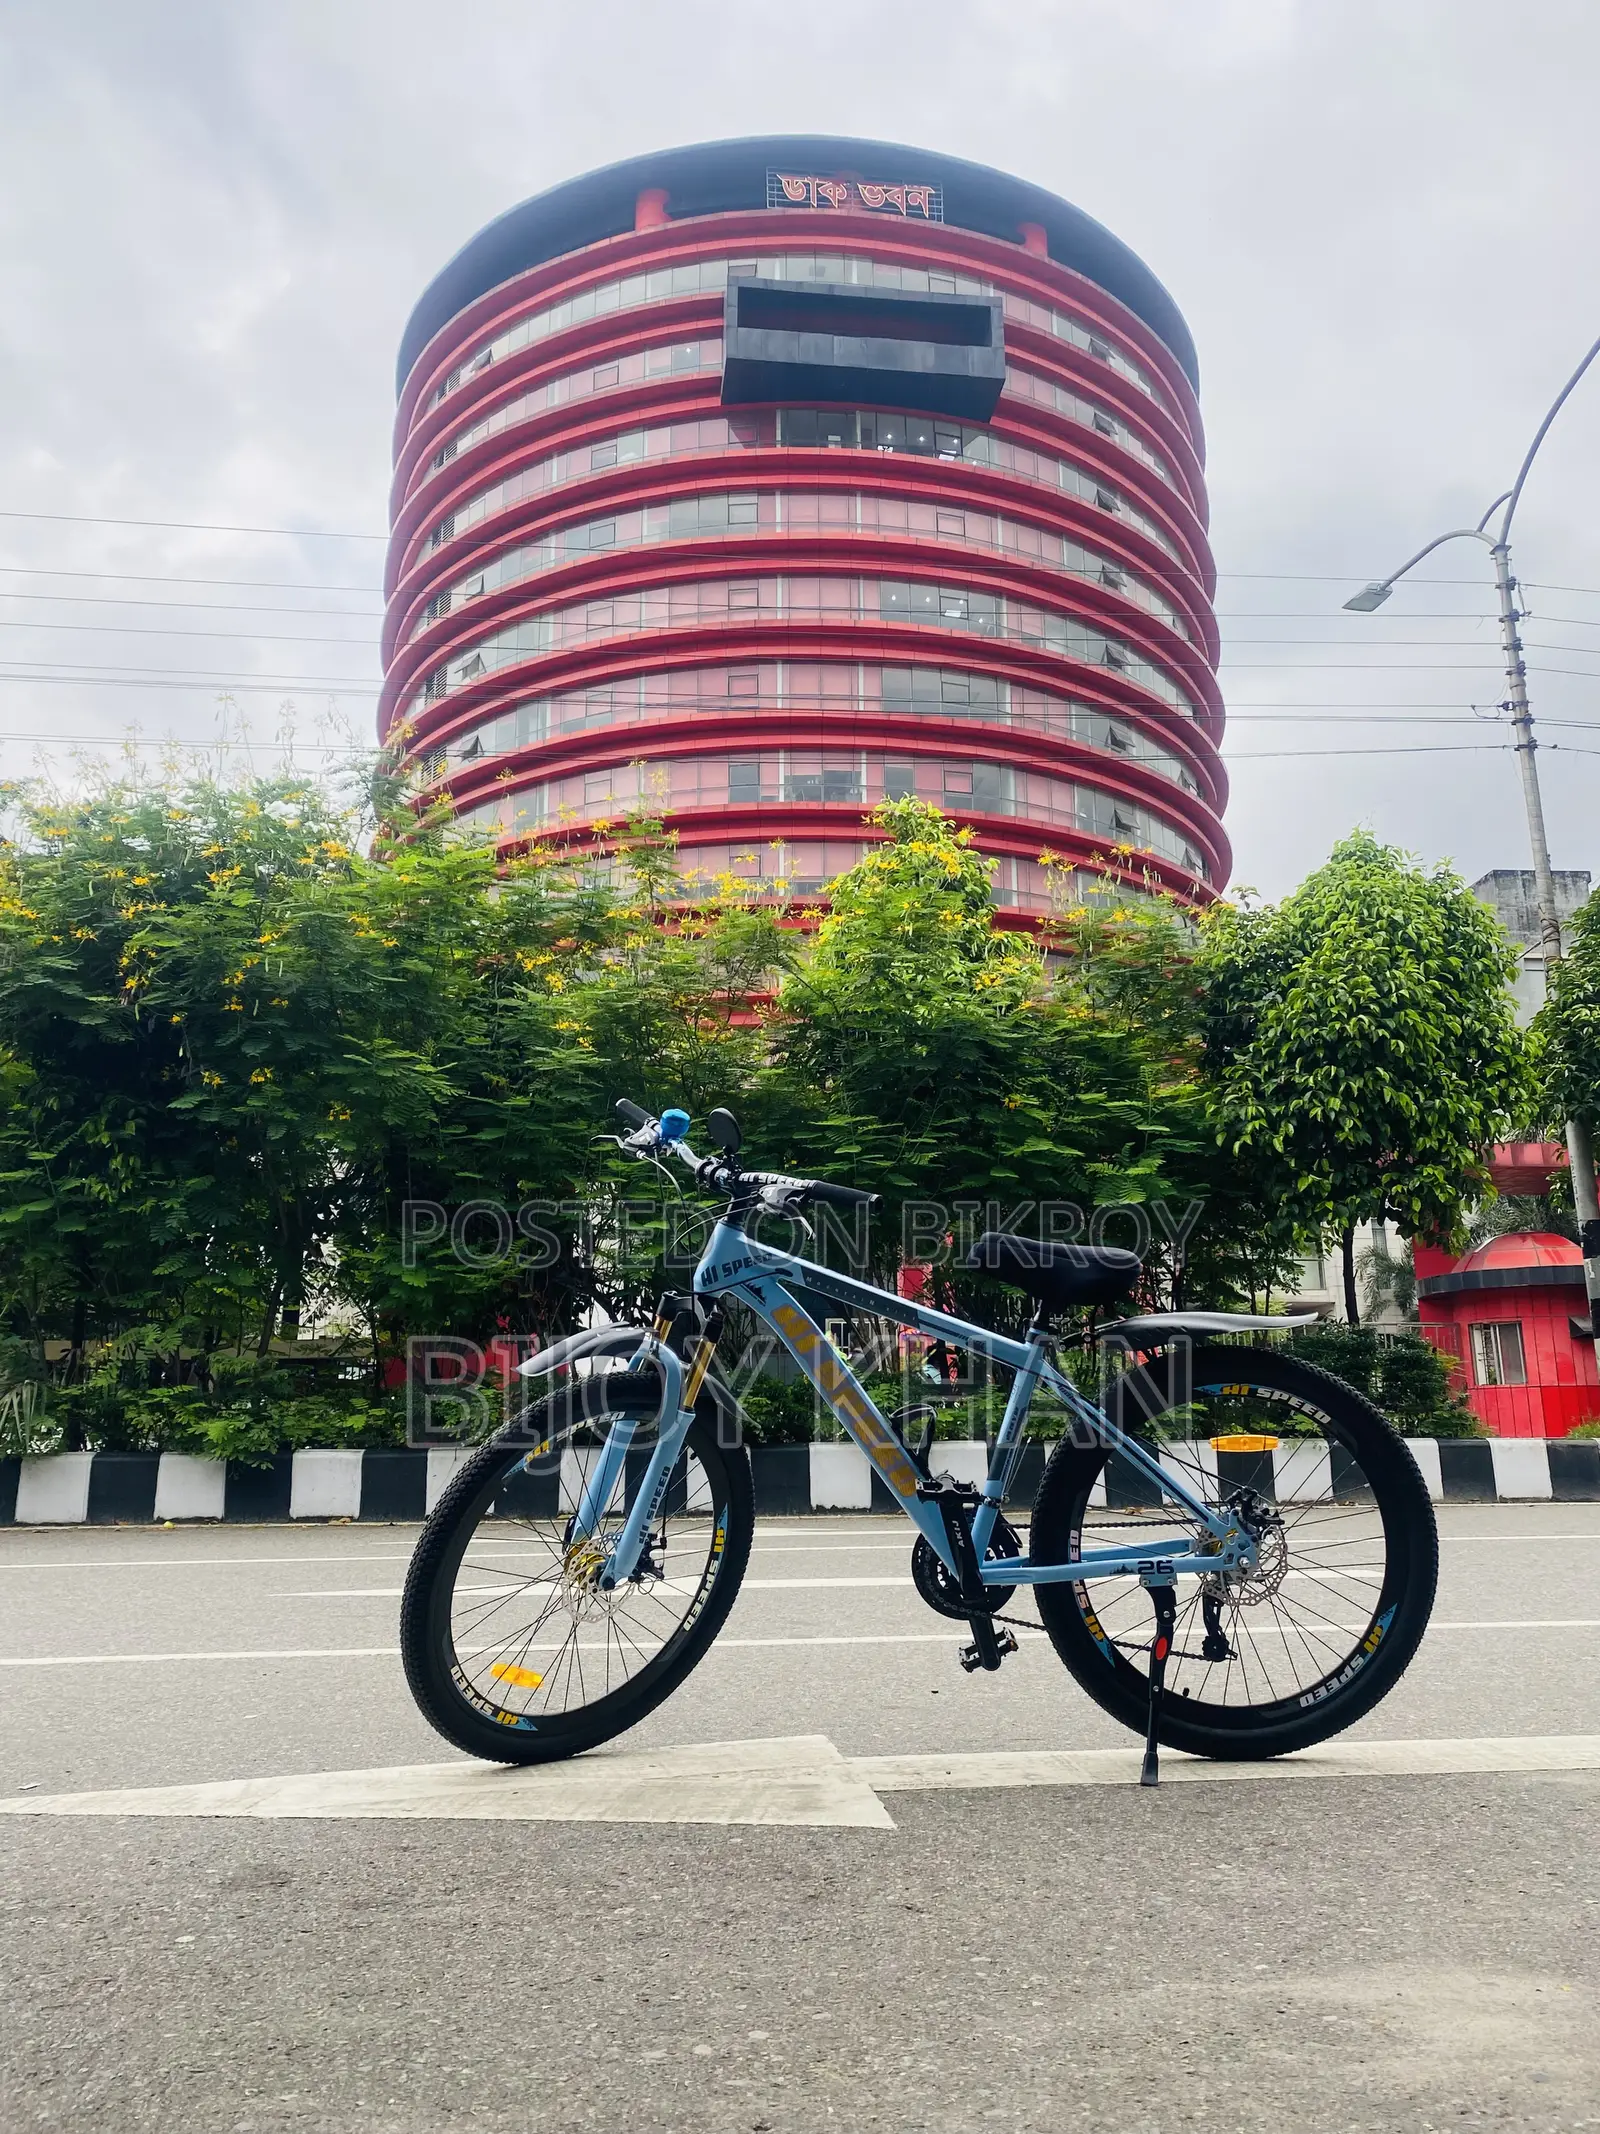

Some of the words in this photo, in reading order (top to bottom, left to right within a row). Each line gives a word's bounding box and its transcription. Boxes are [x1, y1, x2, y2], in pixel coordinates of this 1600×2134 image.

[776, 173, 848, 208] ডাক
[856, 182, 935, 219] ভবন
[701, 1265, 718, 1287] HI
[721, 1253, 773, 1278] SPEED
[770, 1304, 818, 1354] HI
[1222, 1384, 1250, 1395] HI
[1256, 1388, 1331, 1424] SPEED
[556, 1411, 625, 1442] SPEED
[647, 1466, 671, 1520] SPEED
[714, 1528, 725, 1553] HI
[951, 1520, 965, 1548] AKIJ
[1069, 1529, 1090, 1609] SPED
[1137, 1560, 1175, 1575] 26
[683, 1559, 719, 1632] SPEED
[1363, 1626, 1384, 1654] HI
[450, 1664, 494, 1716] SPEED
[1300, 1653, 1365, 1708] SPEED
[496, 1710, 519, 1725] HI
